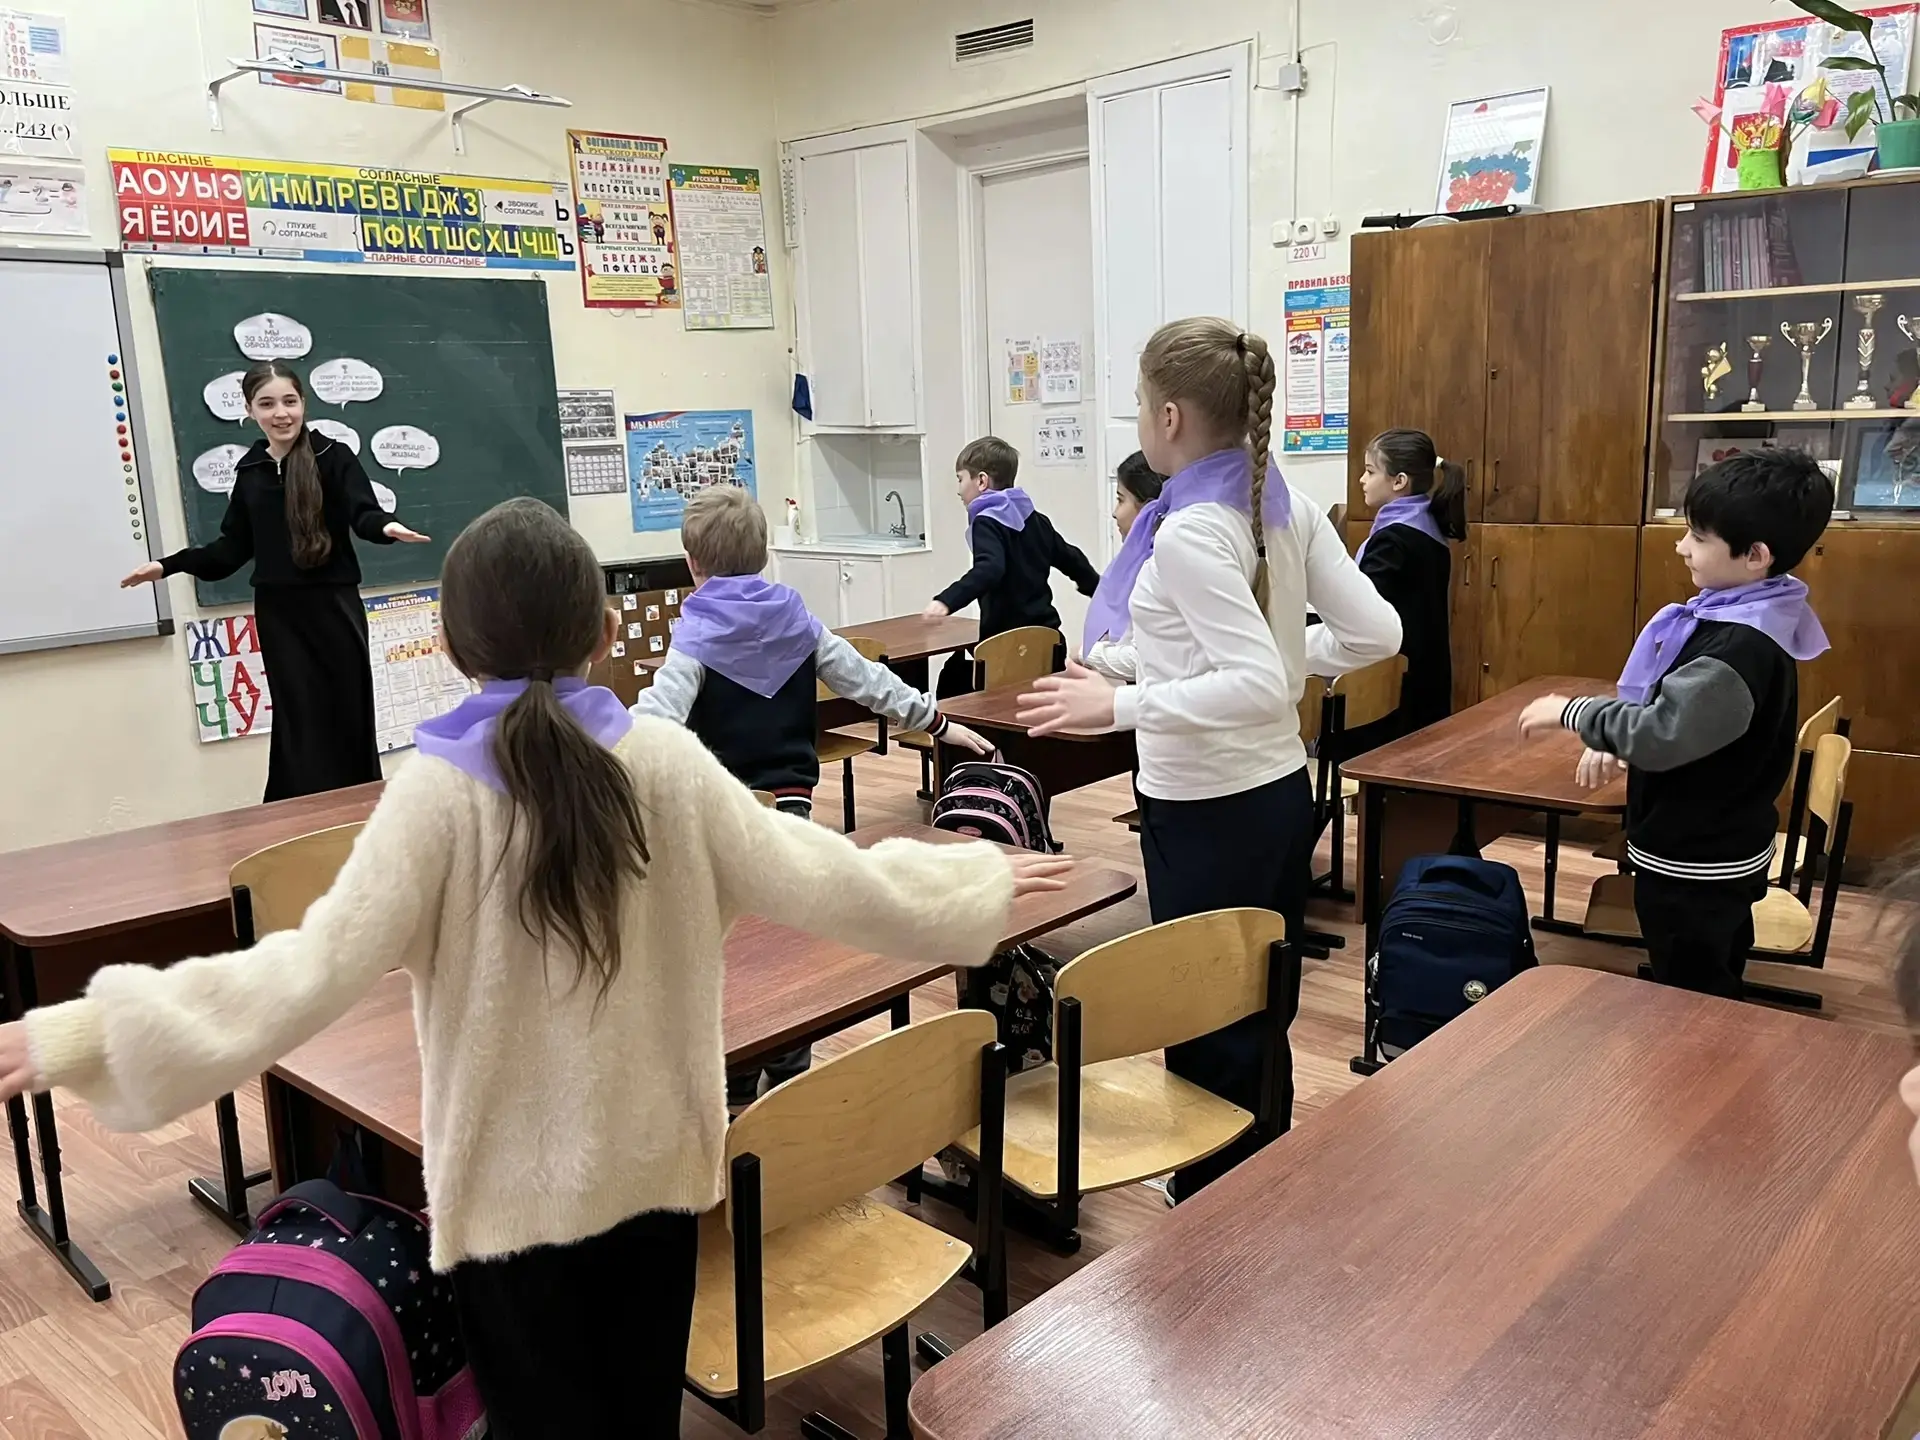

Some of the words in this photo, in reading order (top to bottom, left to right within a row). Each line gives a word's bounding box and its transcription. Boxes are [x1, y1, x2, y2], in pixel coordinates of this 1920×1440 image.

[588, 148, 630, 157] РУССКОГО
[137, 152, 213, 166] ГЛАСНЫЕ
[359, 168, 441, 184] СОГЛАСНЫЕ
[508, 200, 538, 208] ЗВОНКИЕ
[504, 207, 544, 216] СОГЛАСНЫЕ
[286, 222, 316, 230] ГЛУХИЕ
[278, 230, 328, 239] СОГЛАСНЫЕ
[1294, 247, 1309, 259] 220
[1312, 246, 1318, 256] V
[372, 253, 418, 264] ПАРНЫЕ
[419, 255, 481, 266] СОГЛАСНЫЕ
[1288, 278, 1328, 290] ПРАВИЛА
[630, 421, 646, 430] МЫ
[648, 420, 680, 430] ВМЕСТЕ
[379, 442, 425, 451] ДВИЖЕНИЕ
[374, 596, 432, 610] МАТЕМАТИКА
[186, 614, 261, 661] ЖИ
[261, 1370, 316, 1402] LOVE
